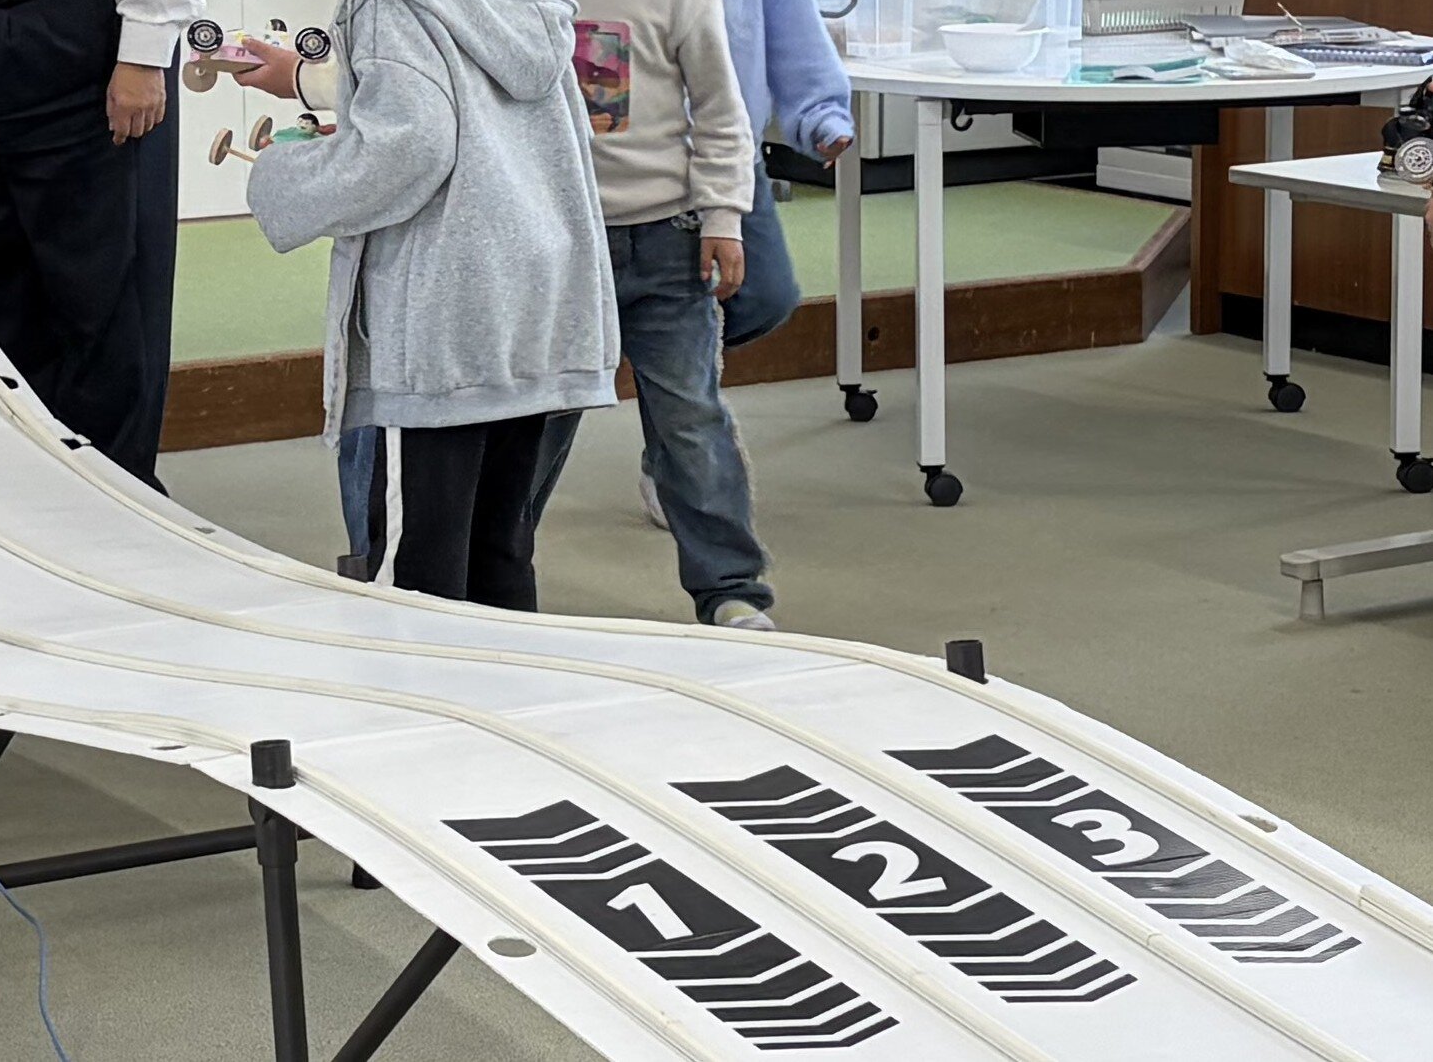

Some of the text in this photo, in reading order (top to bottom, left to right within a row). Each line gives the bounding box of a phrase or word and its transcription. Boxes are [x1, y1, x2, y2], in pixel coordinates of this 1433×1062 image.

[1051, 808, 1160, 866] 3
[831, 840, 948, 902] 2
[606, 882, 694, 940] 1
